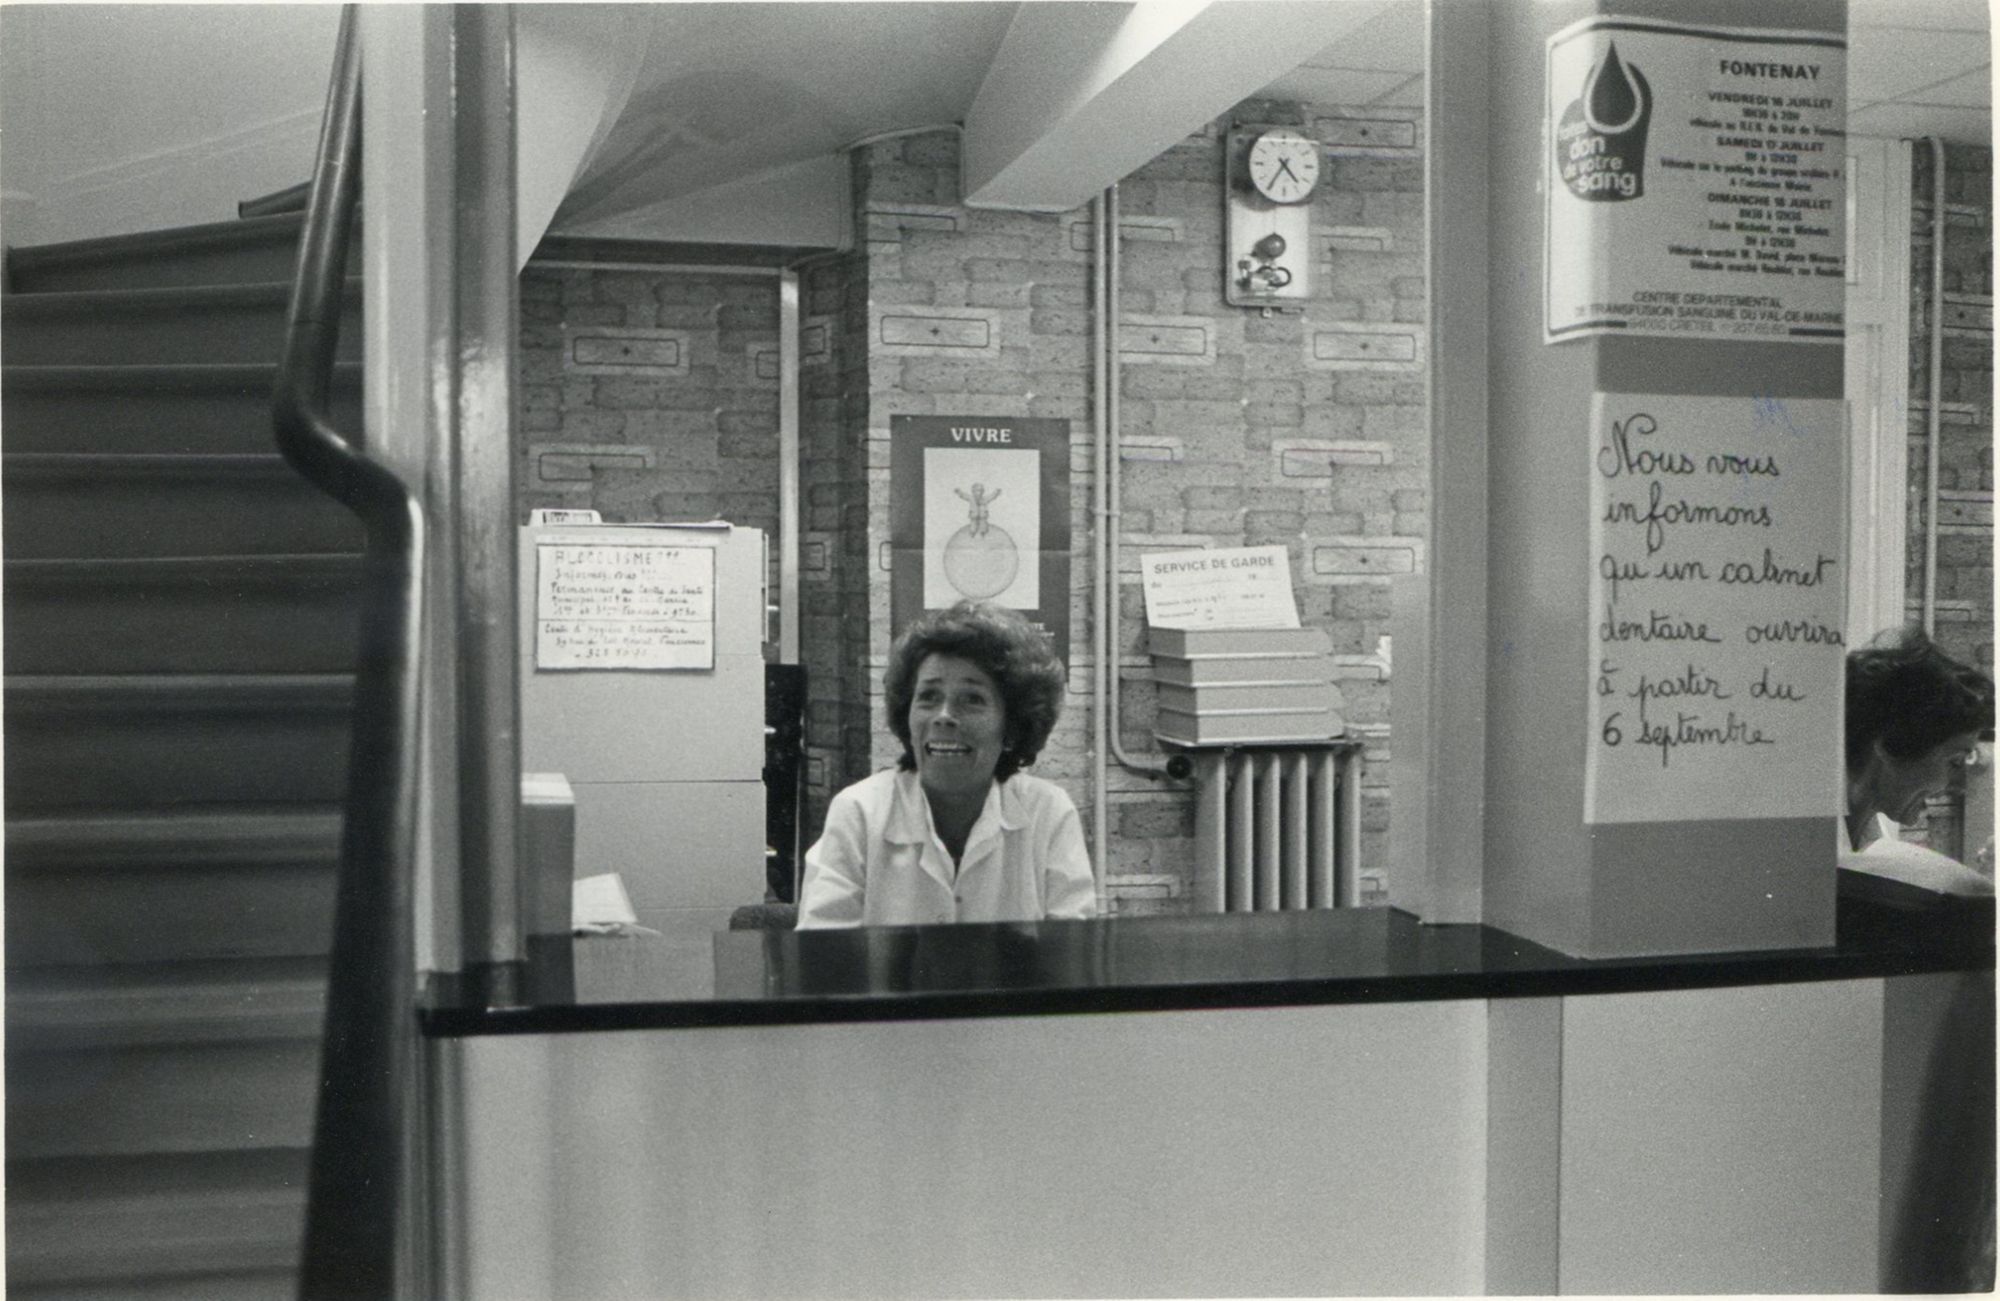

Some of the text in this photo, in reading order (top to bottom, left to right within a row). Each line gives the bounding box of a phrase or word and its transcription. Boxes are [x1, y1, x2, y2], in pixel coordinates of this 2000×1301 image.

[1719, 59, 1820, 81] FONTENAY
[1707, 91, 1769, 106] VENDREDI
[1786, 97, 1833, 110] JUILLET
[1569, 135, 1606, 160] don
[1716, 135, 1763, 149] SAMEDI
[1779, 140, 1825, 153] JUILLET
[1578, 155, 1623, 173] votre
[1578, 170, 1637, 197] sang
[1707, 192, 1770, 207] DIMANCHE
[1790, 197, 1833, 210] JUILLET
[1632, 290, 1783, 309] CENTRE DEPARTEMENTAL
[1590, 302, 1675, 317] TRANSFUSION
[1677, 305, 1736, 320] SANGUINE
[951, 427, 1012, 443] VIVRE
[1598, 412, 1780, 478] Nous vous
[1603, 480, 1772, 555] informons
[1154, 556, 1275, 574] SERVICE DE GARDE
[1718, 547, 1836, 588] cabinet
[1600, 603, 1847, 648] dentaire ouvrira
[1597, 659, 1807, 722] à partir du
[1602, 711, 1775, 768] 6 septembre
